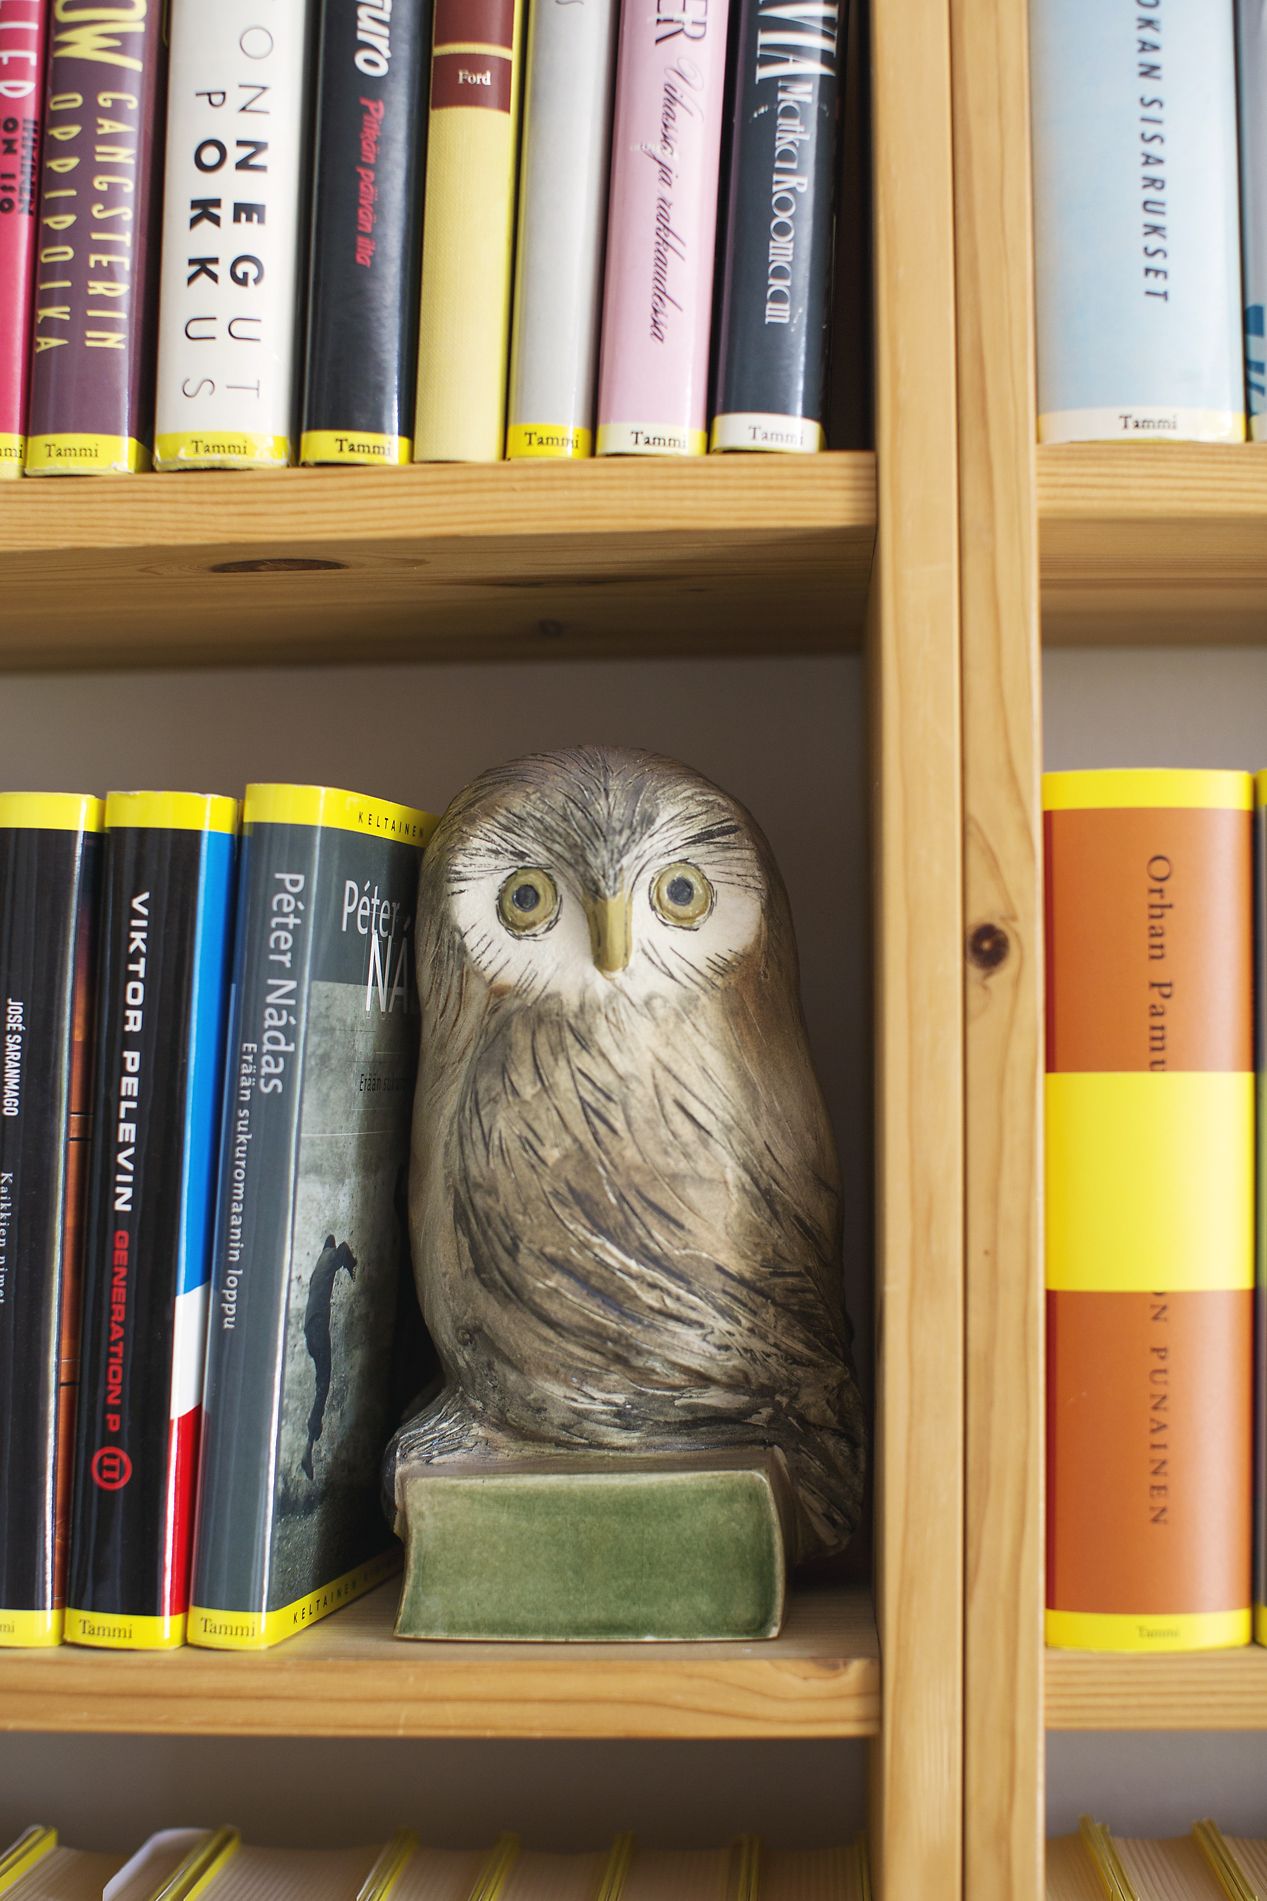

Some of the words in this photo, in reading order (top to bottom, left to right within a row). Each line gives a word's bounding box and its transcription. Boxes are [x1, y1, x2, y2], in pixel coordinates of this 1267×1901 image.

[756, 0, 838, 85] VIA
[458, 69, 491, 86] Ford
[661, 57, 704, 157] Vihassa
[2, 117, 19, 154] ON
[359, 96, 385, 164] Pitkän
[775, 79, 813, 169] Matka
[0, 173, 17, 214] ISO
[355, 166, 378, 224] päivän
[645, 146, 679, 188] ja
[36, 92, 83, 353] OPPIPOIKA
[85, 91, 138, 350] GANGSTERIN
[225, 26, 274, 399] ONNEGUT
[1139, 96, 1169, 302] SISARUKSET
[182, 90, 227, 400] POKKUS
[354, 236, 377, 268] ilta
[650, 197, 686, 343] rakkaudessa
[765, 173, 808, 325] Roomaan
[45, 443, 99, 458] Tammi
[191, 440, 248, 456] Tammi
[335, 438, 392, 457] Tammi
[524, 431, 580, 449] Tammi
[631, 430, 687, 449] Tammi
[749, 425, 804, 445] Tammi
[1119, 413, 1178, 430] Tammi
[268, 872, 305, 968] Péter
[341, 879, 401, 939] Péter
[1146, 853, 1174, 962] Orhan
[123, 891, 150, 1034] VIKTOR
[7, 998, 26, 1031] JOSÉ
[259, 978, 298, 1094] Nádas
[239, 1042, 258, 1101] Erään
[114, 1051, 141, 1212] PELEVIN
[228, 1108, 252, 1262] sukuromaanin
[105, 1229, 130, 1406] GENERATION
[222, 1268, 244, 1330] loppu
[105, 1413, 121, 1433] P
[1149, 1345, 1169, 1526] PUNAINEN
[79, 1618, 133, 1639] Tammi
[200, 1616, 256, 1638] Tammi
